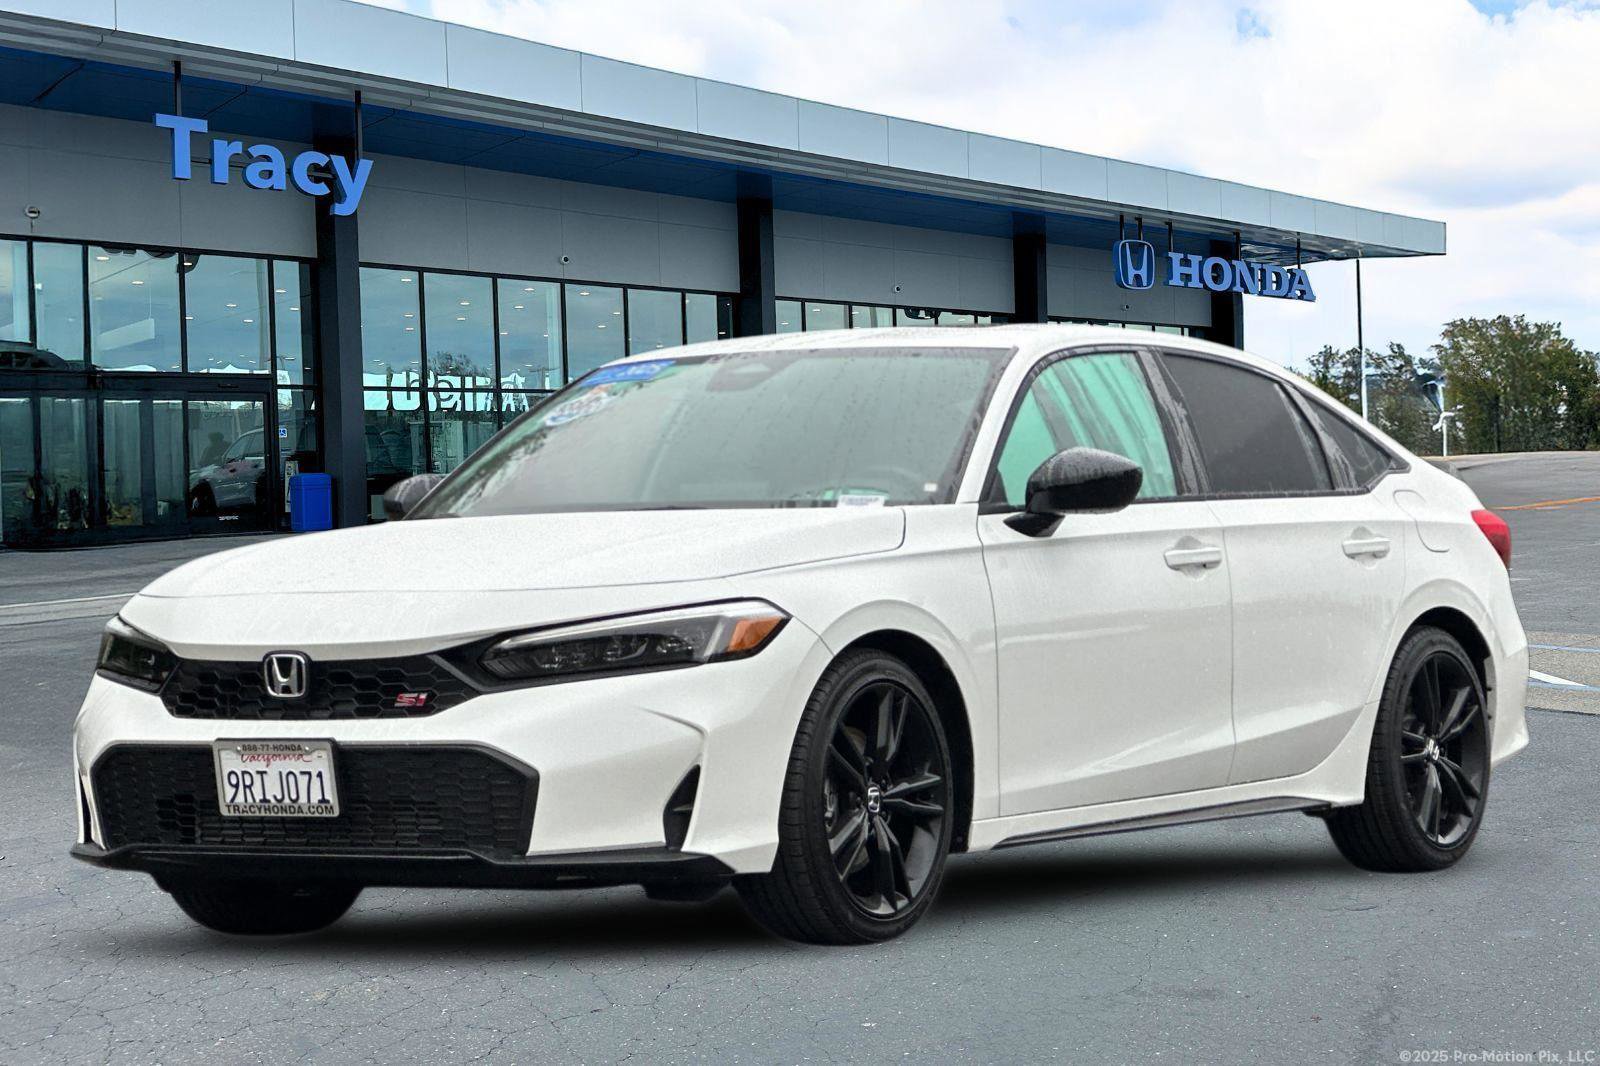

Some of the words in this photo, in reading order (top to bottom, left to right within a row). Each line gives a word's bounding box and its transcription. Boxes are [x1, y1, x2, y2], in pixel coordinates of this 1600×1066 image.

[153, 113, 374, 216] Tracy
[1166, 251, 1317, 302] HONDA
[227, 770, 330, 804] 9RIJ071
[225, 804, 335, 815] TRACYHONDA.COM
